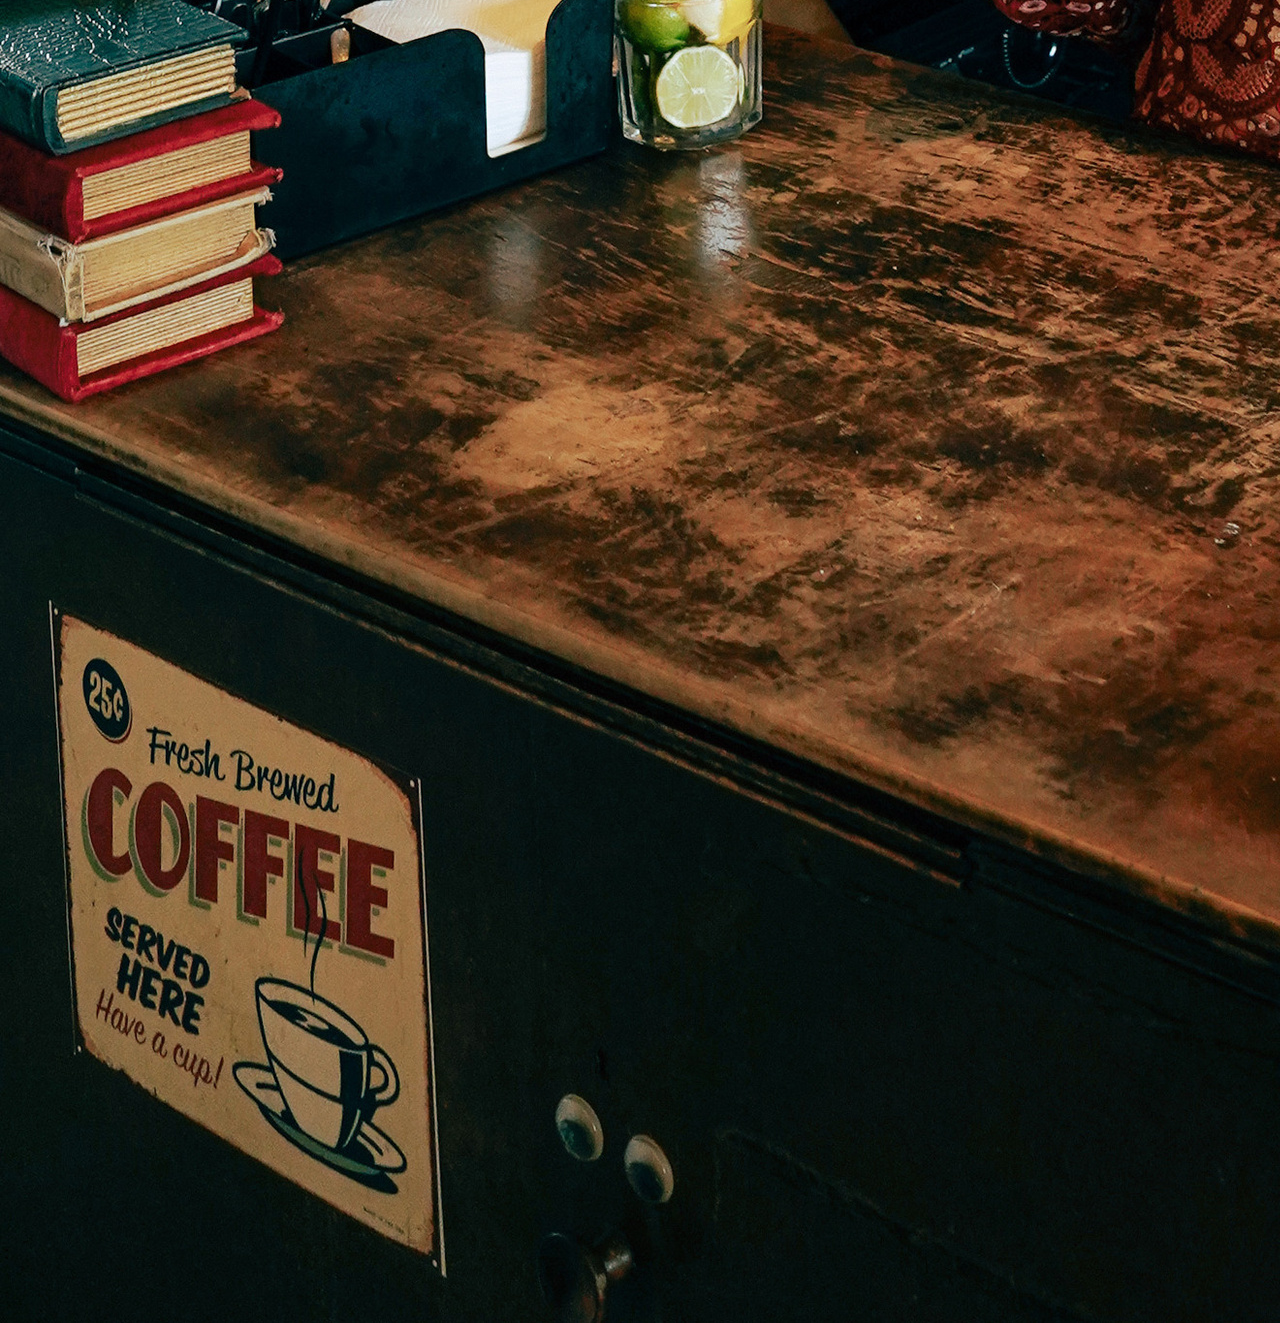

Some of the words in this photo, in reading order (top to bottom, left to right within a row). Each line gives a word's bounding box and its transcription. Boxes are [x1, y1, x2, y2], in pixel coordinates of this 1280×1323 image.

[87, 668, 126, 724] 25¢
[145, 726, 227, 783] Fresh
[229, 747, 340, 815] Brewed
[84, 766, 396, 963] COFFEE
[103, 905, 212, 991] SERVED
[115, 952, 206, 1037] HERE
[94, 987, 147, 1046] Have
[150, 1032, 169, 1060] a
[170, 1047, 226, 1090] cup!
